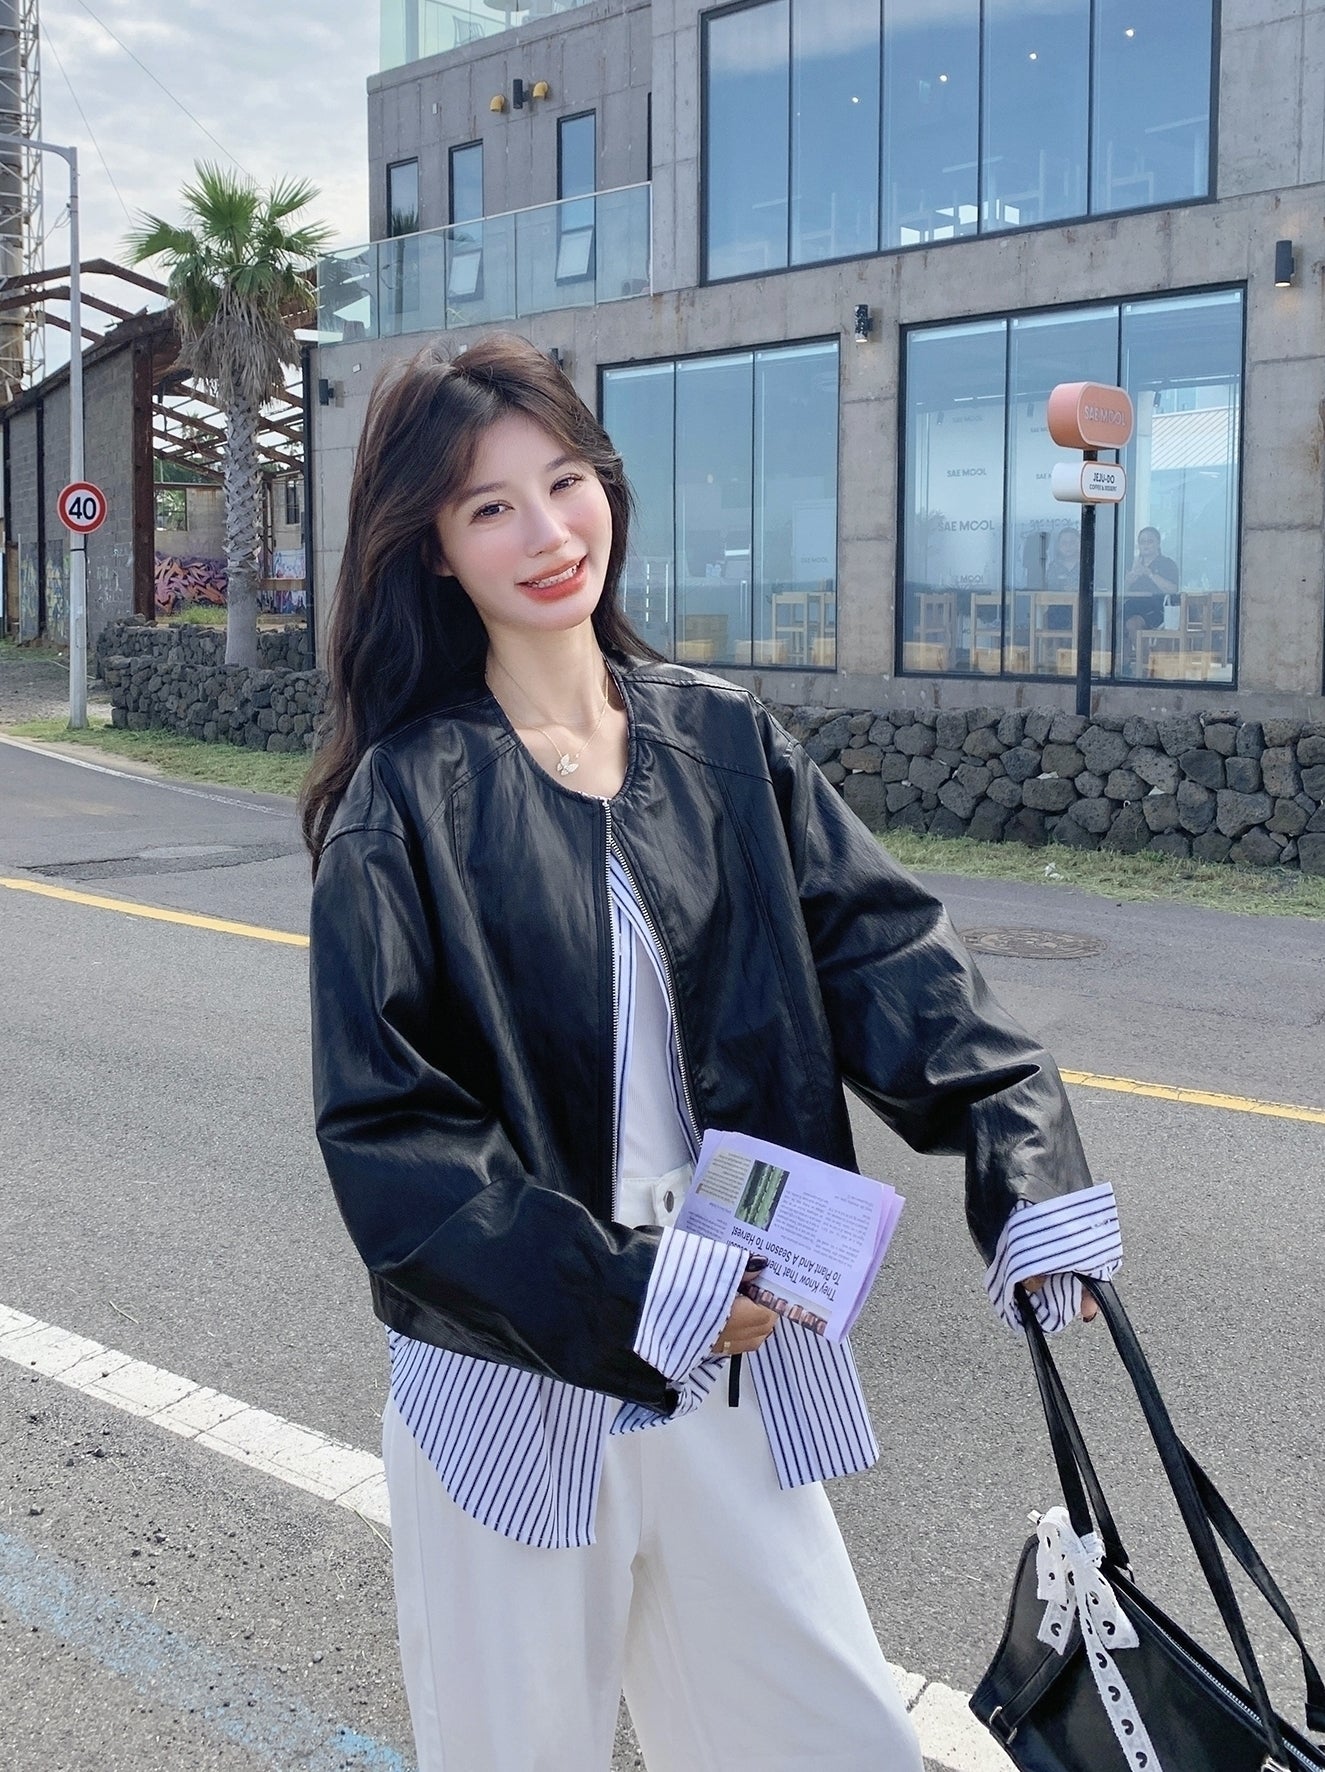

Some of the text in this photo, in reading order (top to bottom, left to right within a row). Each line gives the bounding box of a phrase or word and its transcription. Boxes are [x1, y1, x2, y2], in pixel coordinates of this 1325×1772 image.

[1084, 405, 1099, 421] SAE
[946, 469, 961, 478] SAE
[1093, 472, 1116, 484] JEJU-DO
[69, 496, 97, 520] 40
[938, 521, 957, 532] SAE
[731, 1226, 756, 1246] Harvest
[755, 1236, 765, 1251] To
[765, 1240, 792, 1263] Season
[792, 1253, 800, 1265] A
[797, 1256, 816, 1273] And
[814, 1263, 833, 1281] Plant
[782, 1266, 799, 1284] That
[832, 1271, 842, 1286] To
[799, 1275, 820, 1293] Know
[818, 1281, 837, 1302] They
